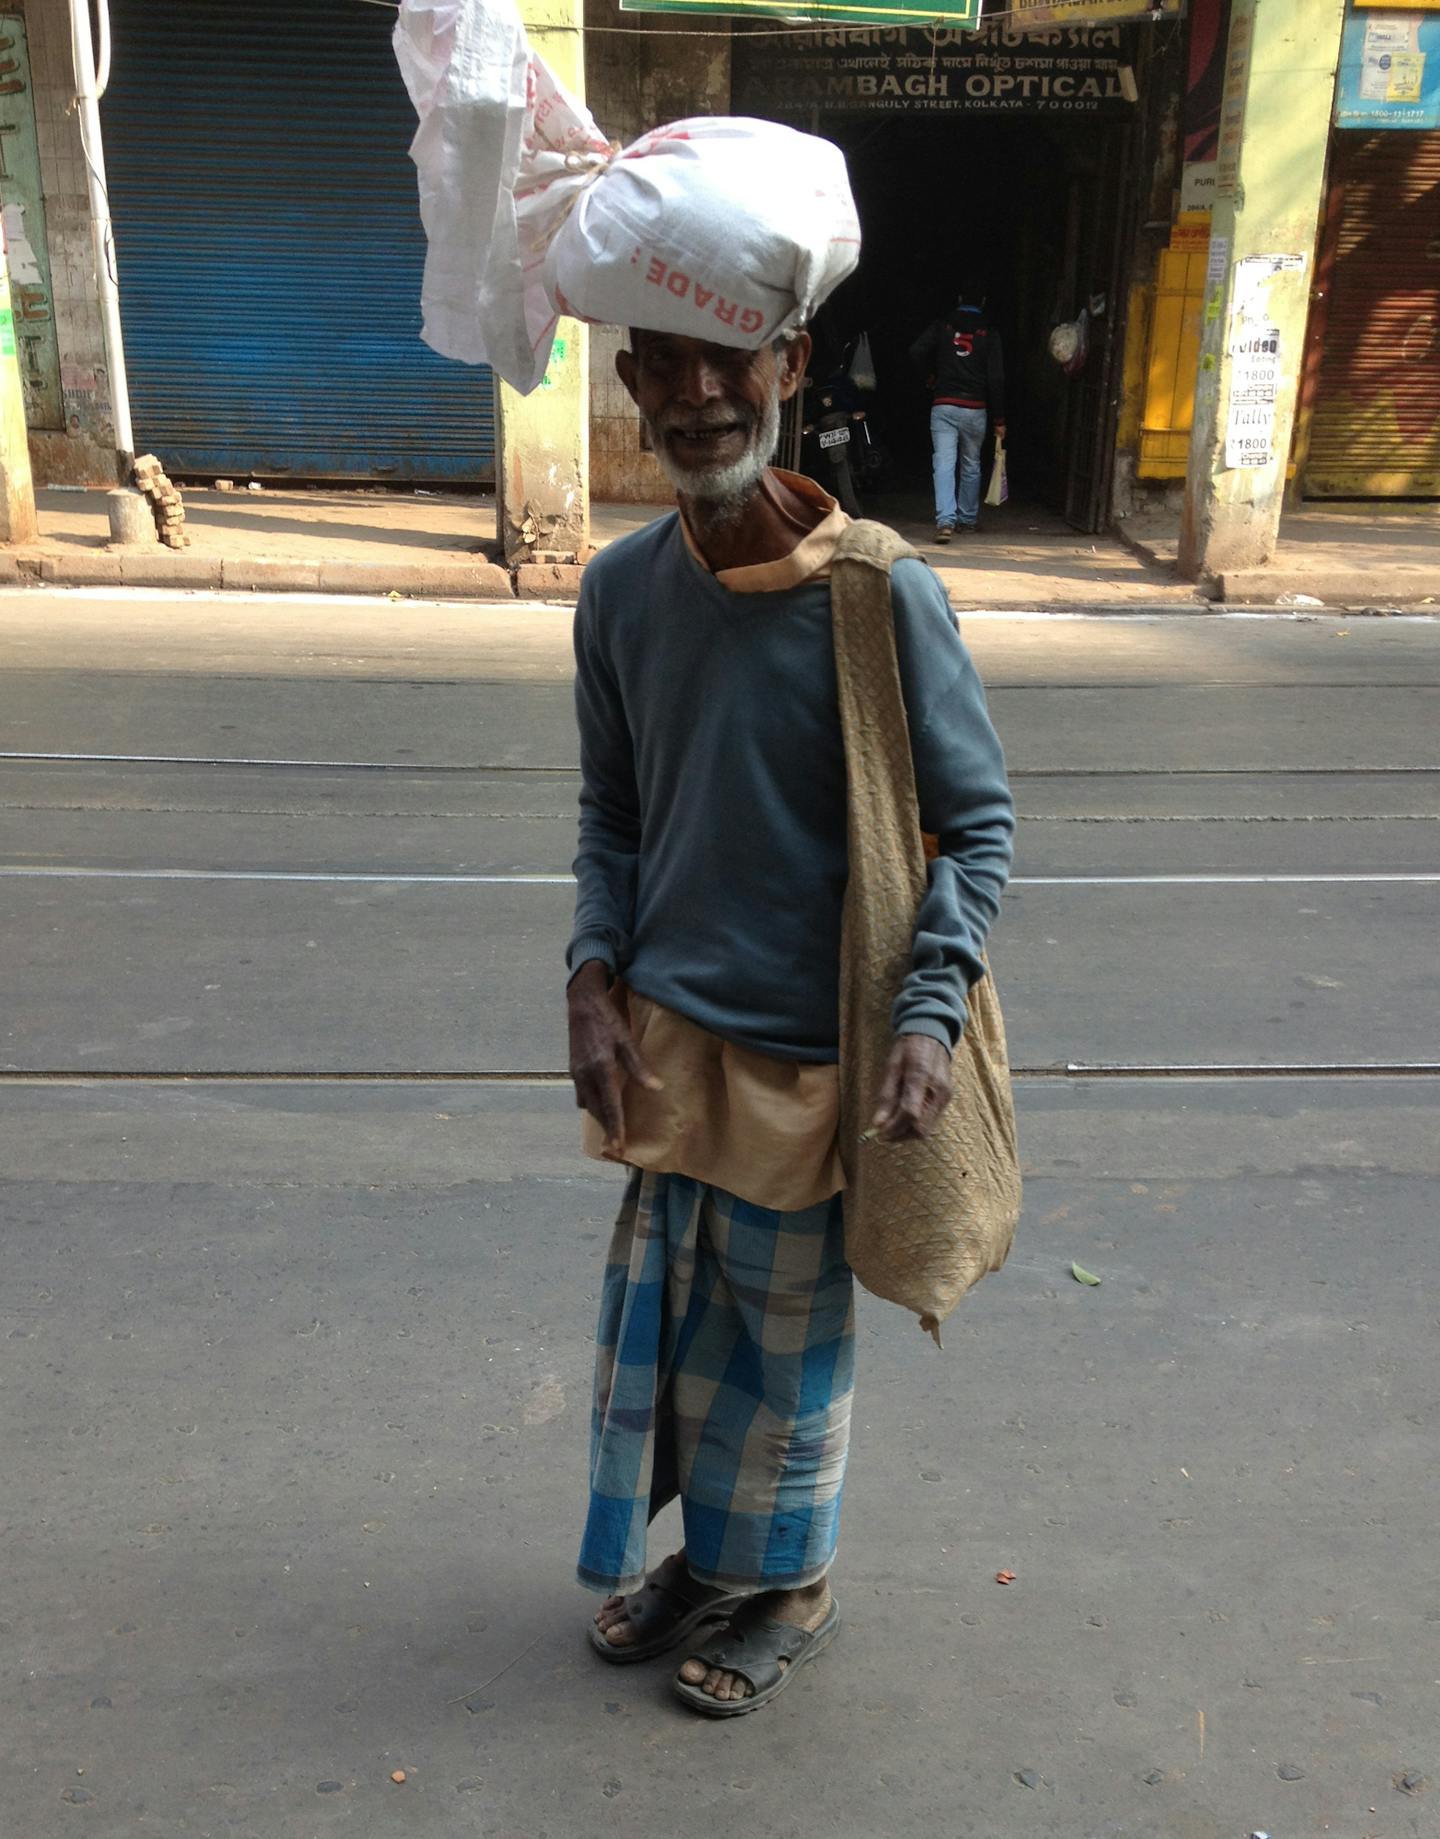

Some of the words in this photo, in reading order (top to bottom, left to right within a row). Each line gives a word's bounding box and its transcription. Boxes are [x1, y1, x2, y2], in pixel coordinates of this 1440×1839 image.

[743, 74, 948, 97] ARAMBAGH
[964, 74, 1122, 98] OPTICAL
[965, 100, 1024, 109] KOLKATA
